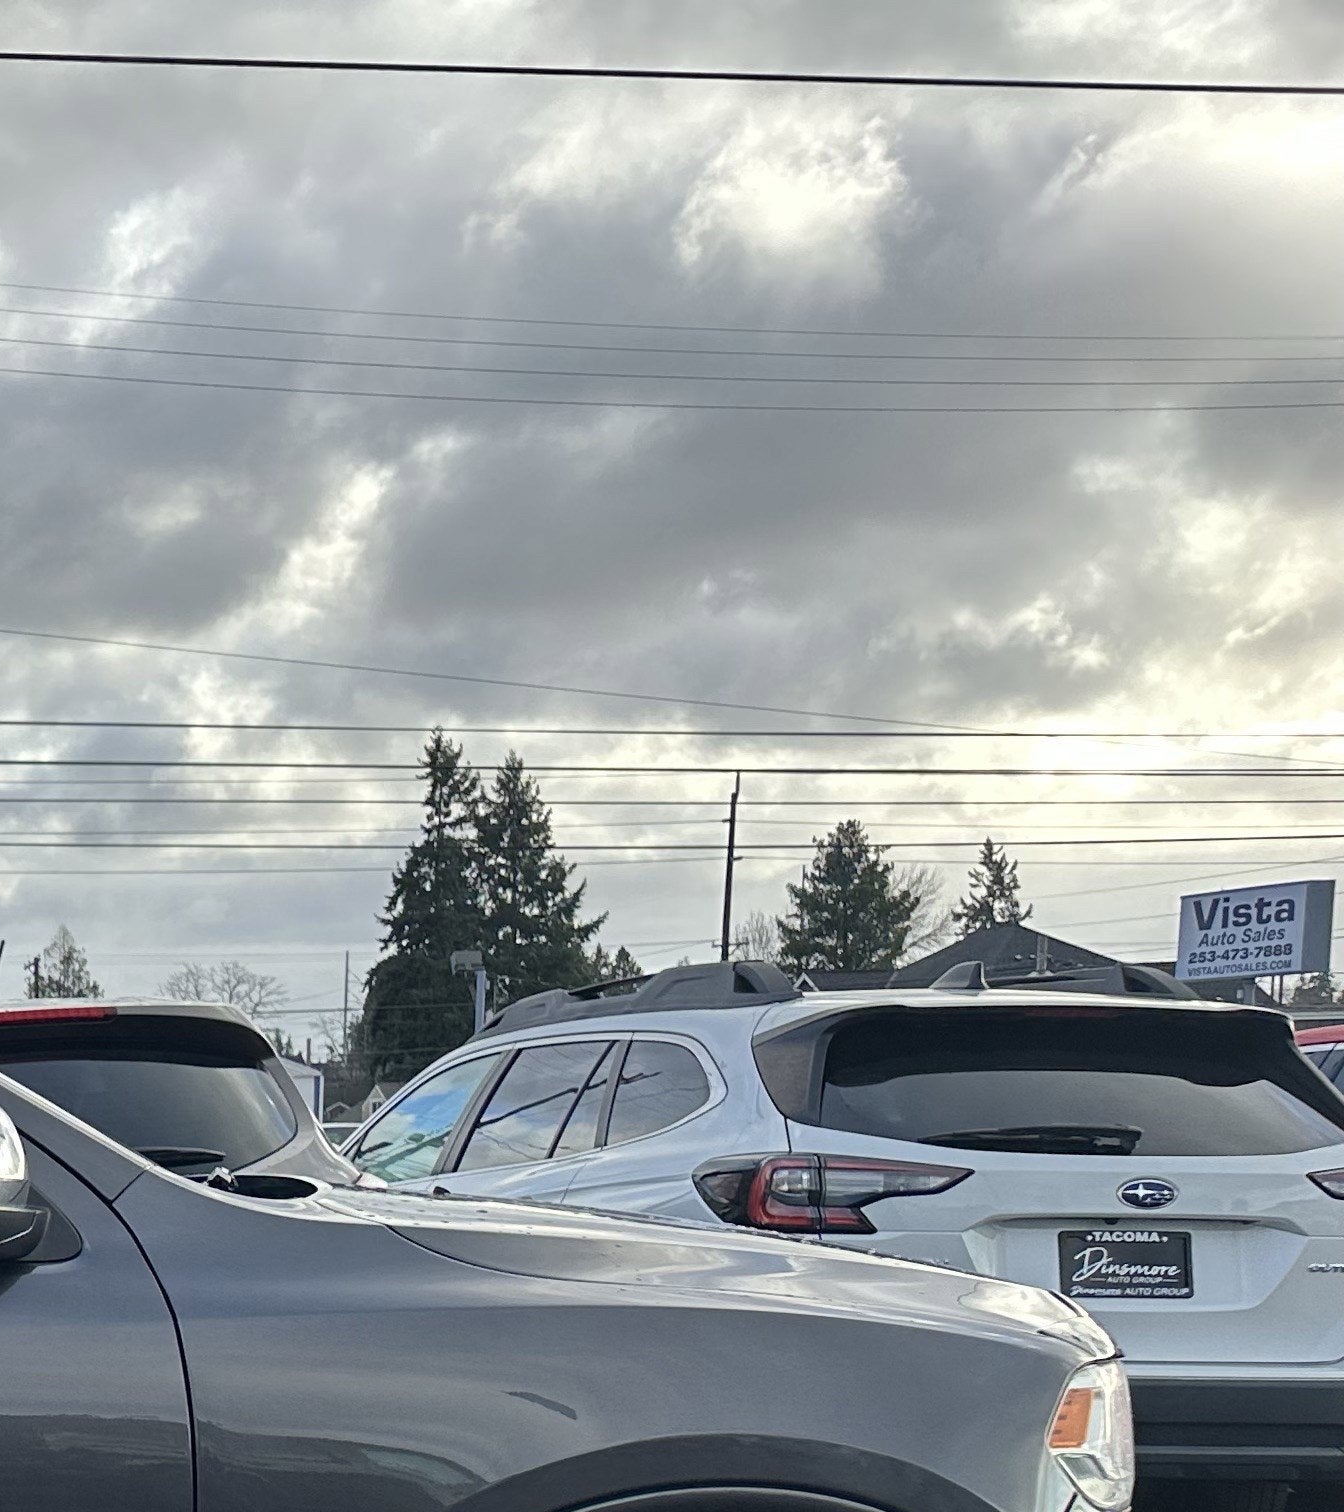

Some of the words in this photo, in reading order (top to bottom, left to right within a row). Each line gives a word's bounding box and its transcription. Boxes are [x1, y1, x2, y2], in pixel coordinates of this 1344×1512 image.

[1193, 896, 1295, 931] Vista
[1197, 933, 1236, 948] Auto
[1241, 926, 1286, 943] Sales
[1187, 959, 1292, 977] VISTAAUTOSALES.COM
[1091, 1231, 1161, 1242] TACOMA
[1072, 1246, 1181, 1282] Dinsmore
[1124, 1287, 1151, 1296] AUTO
[1153, 1287, 1190, 1296] GROUP
